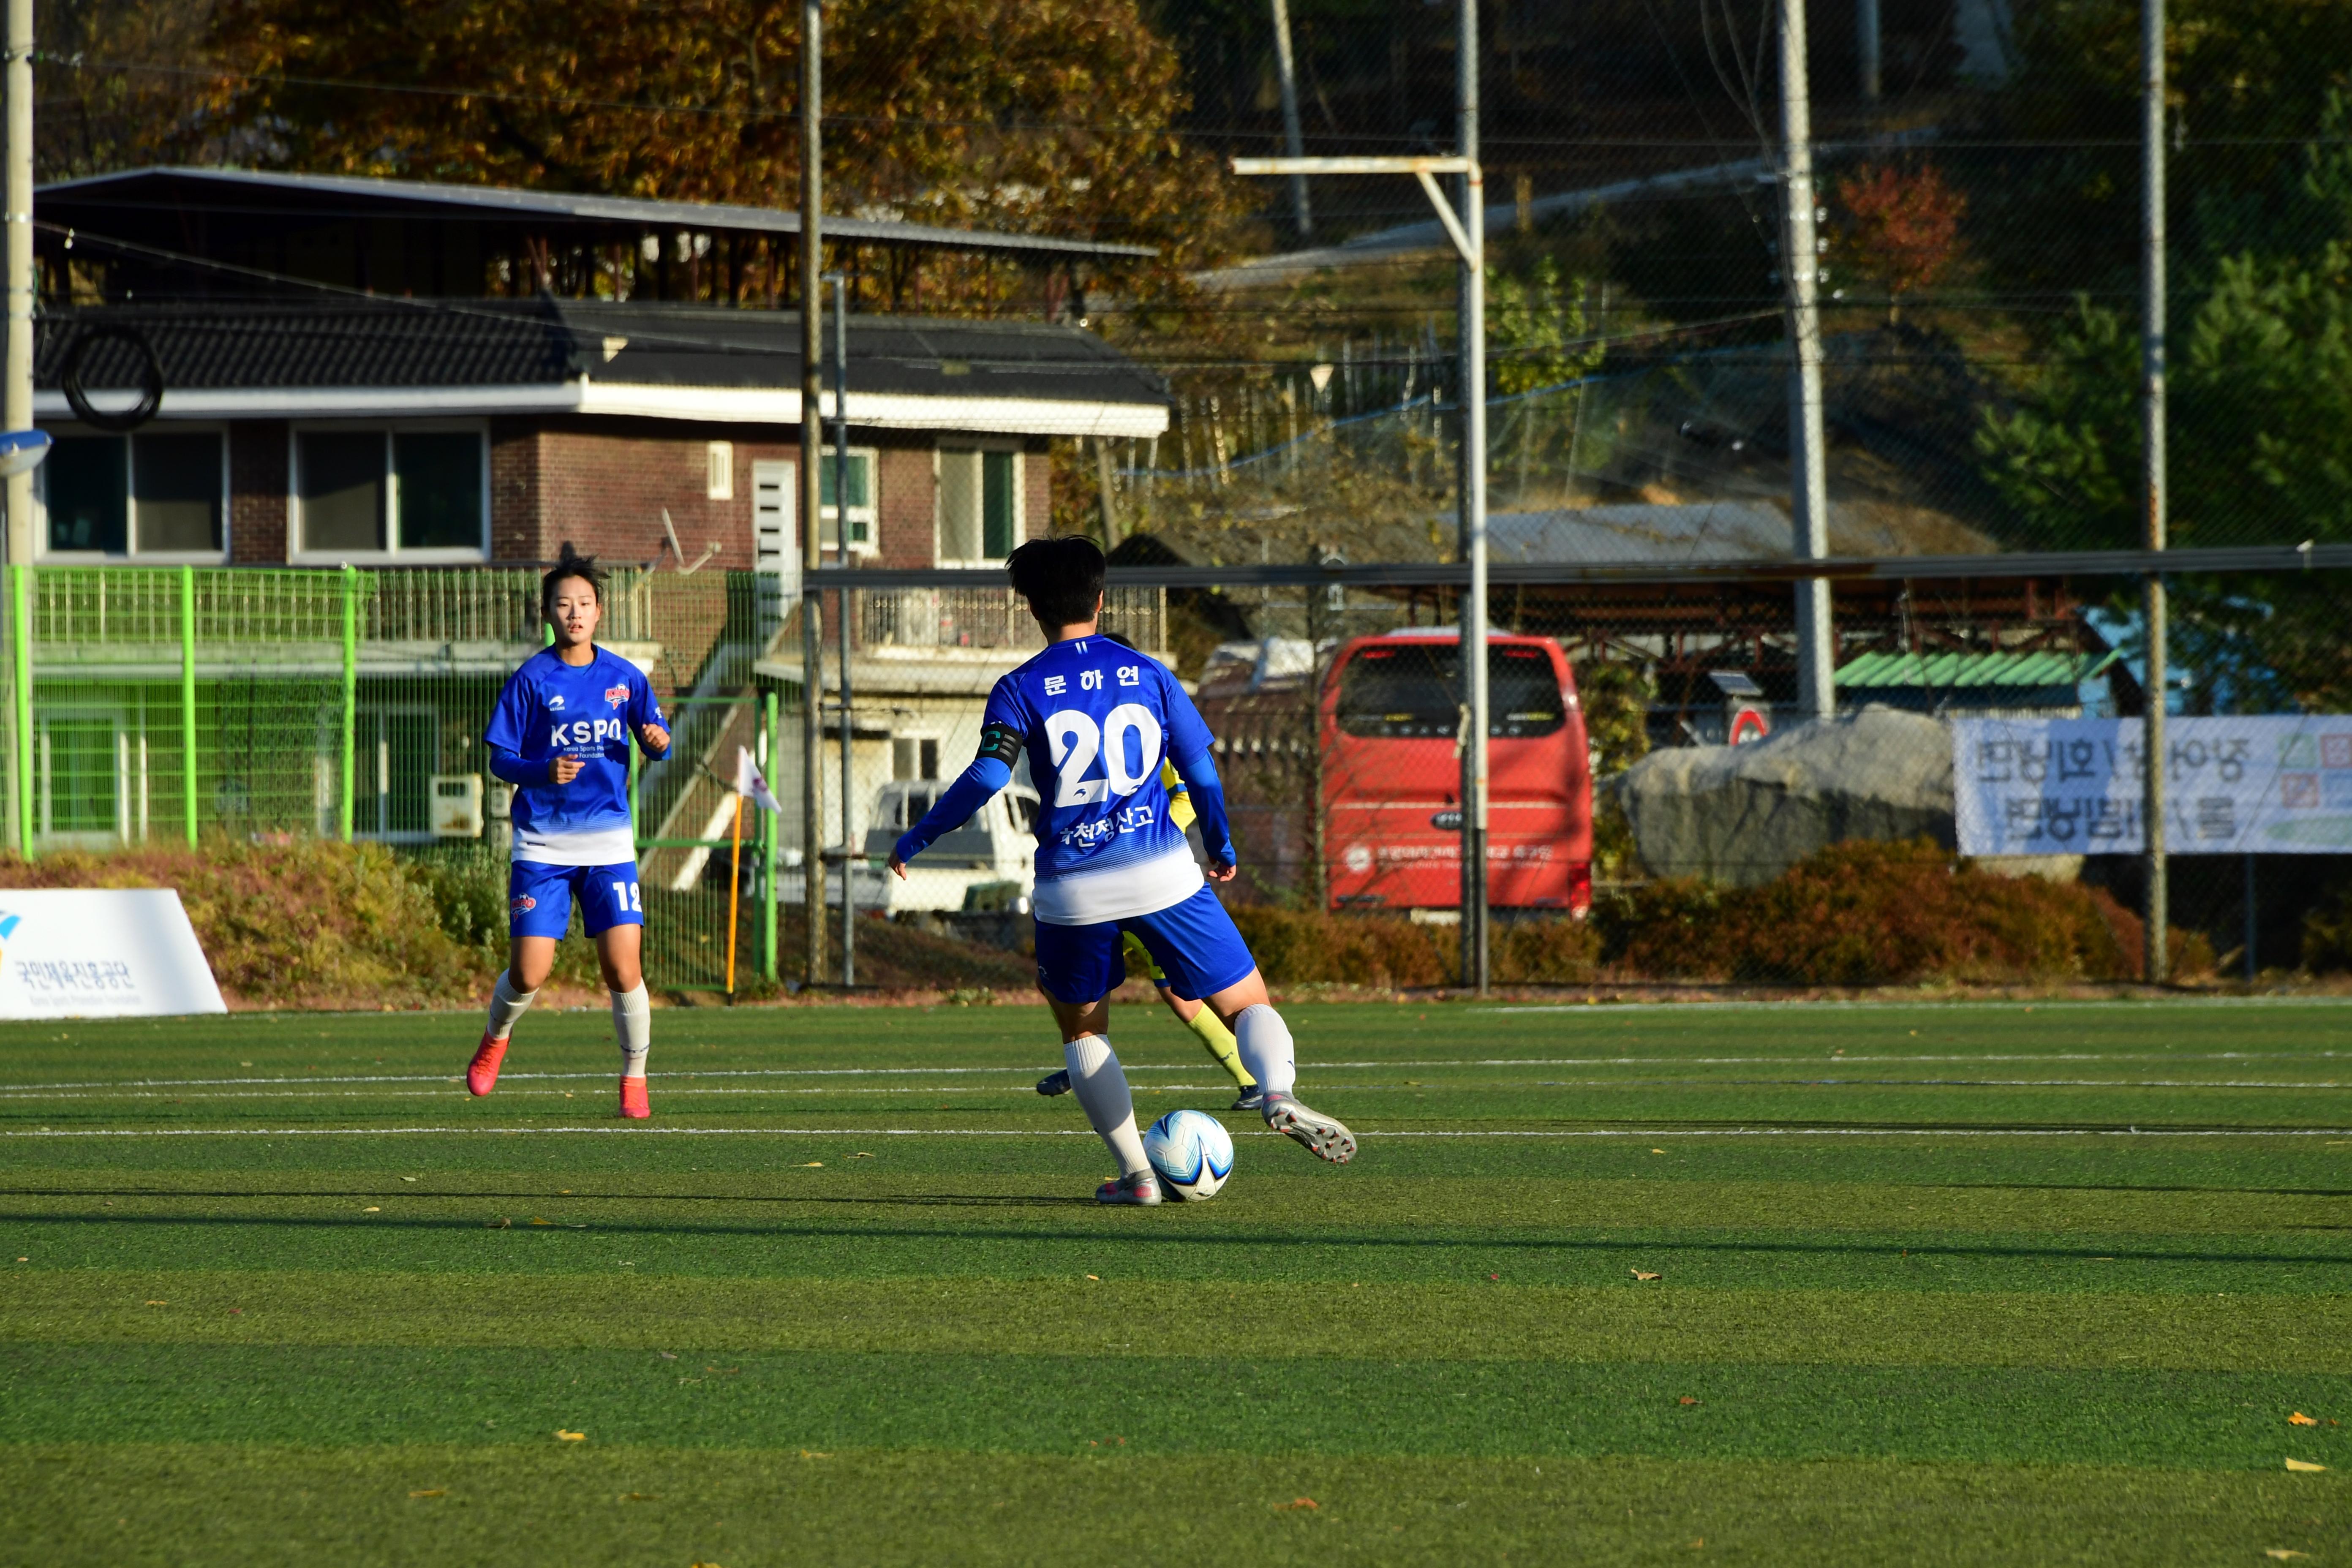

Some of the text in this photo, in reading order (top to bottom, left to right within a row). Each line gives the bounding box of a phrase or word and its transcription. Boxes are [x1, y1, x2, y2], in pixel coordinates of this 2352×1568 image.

[551, 718, 621, 747] KSPO
[980, 730, 1001, 751] C
[1045, 703, 1162, 808] 20
[613, 882, 642, 912] 12
